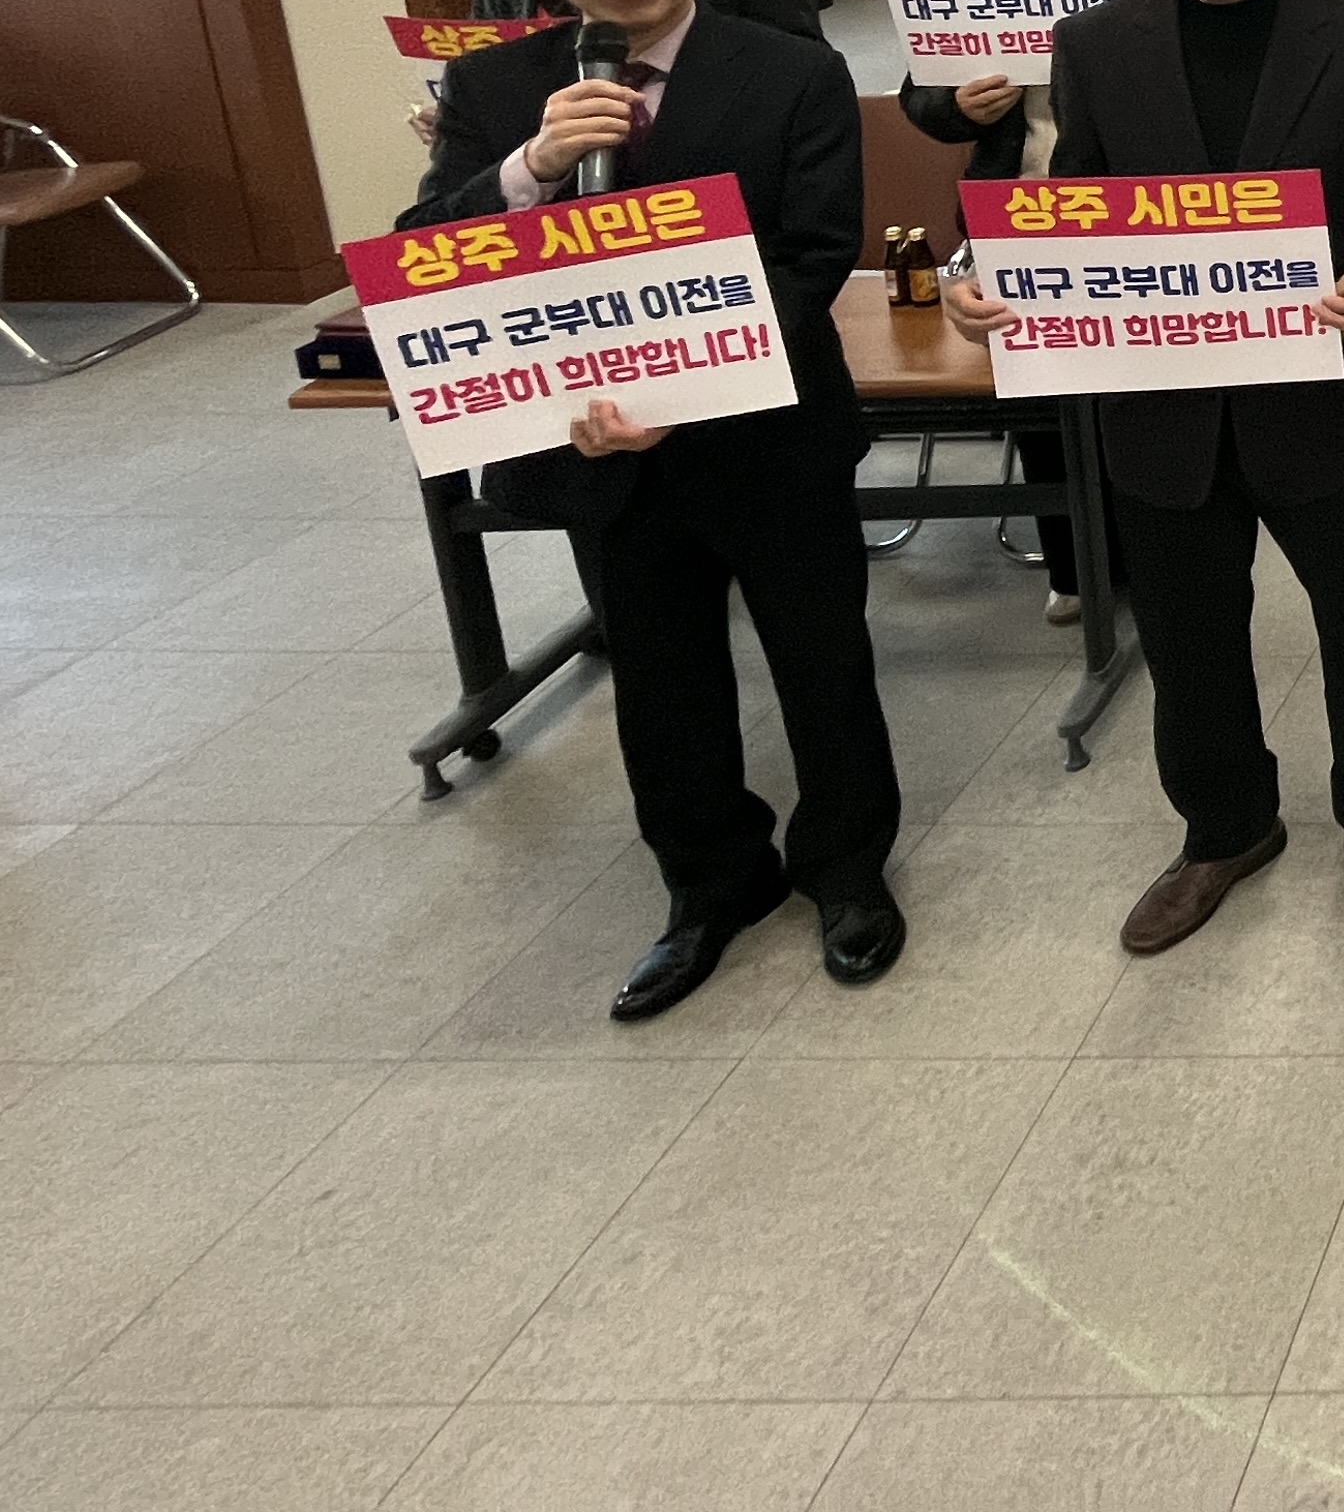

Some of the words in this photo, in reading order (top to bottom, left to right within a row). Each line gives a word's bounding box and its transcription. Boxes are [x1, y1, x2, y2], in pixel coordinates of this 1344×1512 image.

[908, 31, 991, 57] 간절히
[1005, 185, 1110, 232] 상주
[1127, 179, 1283, 227] 시민은
[398, 224, 518, 288] 상주
[540, 189, 706, 262] 시민은
[996, 267, 1074, 300] 대구
[1083, 264, 1198, 300] 군부대
[1209, 259, 1319, 293] 이전을
[396, 316, 493, 371] 대구
[503, 291, 632, 350] 군부대
[642, 272, 757, 320] 이전을
[1002, 316, 1115, 351] 간절히
[409, 366, 552, 426] 간절히
[565, 322, 771, 393] 희망합니다!
